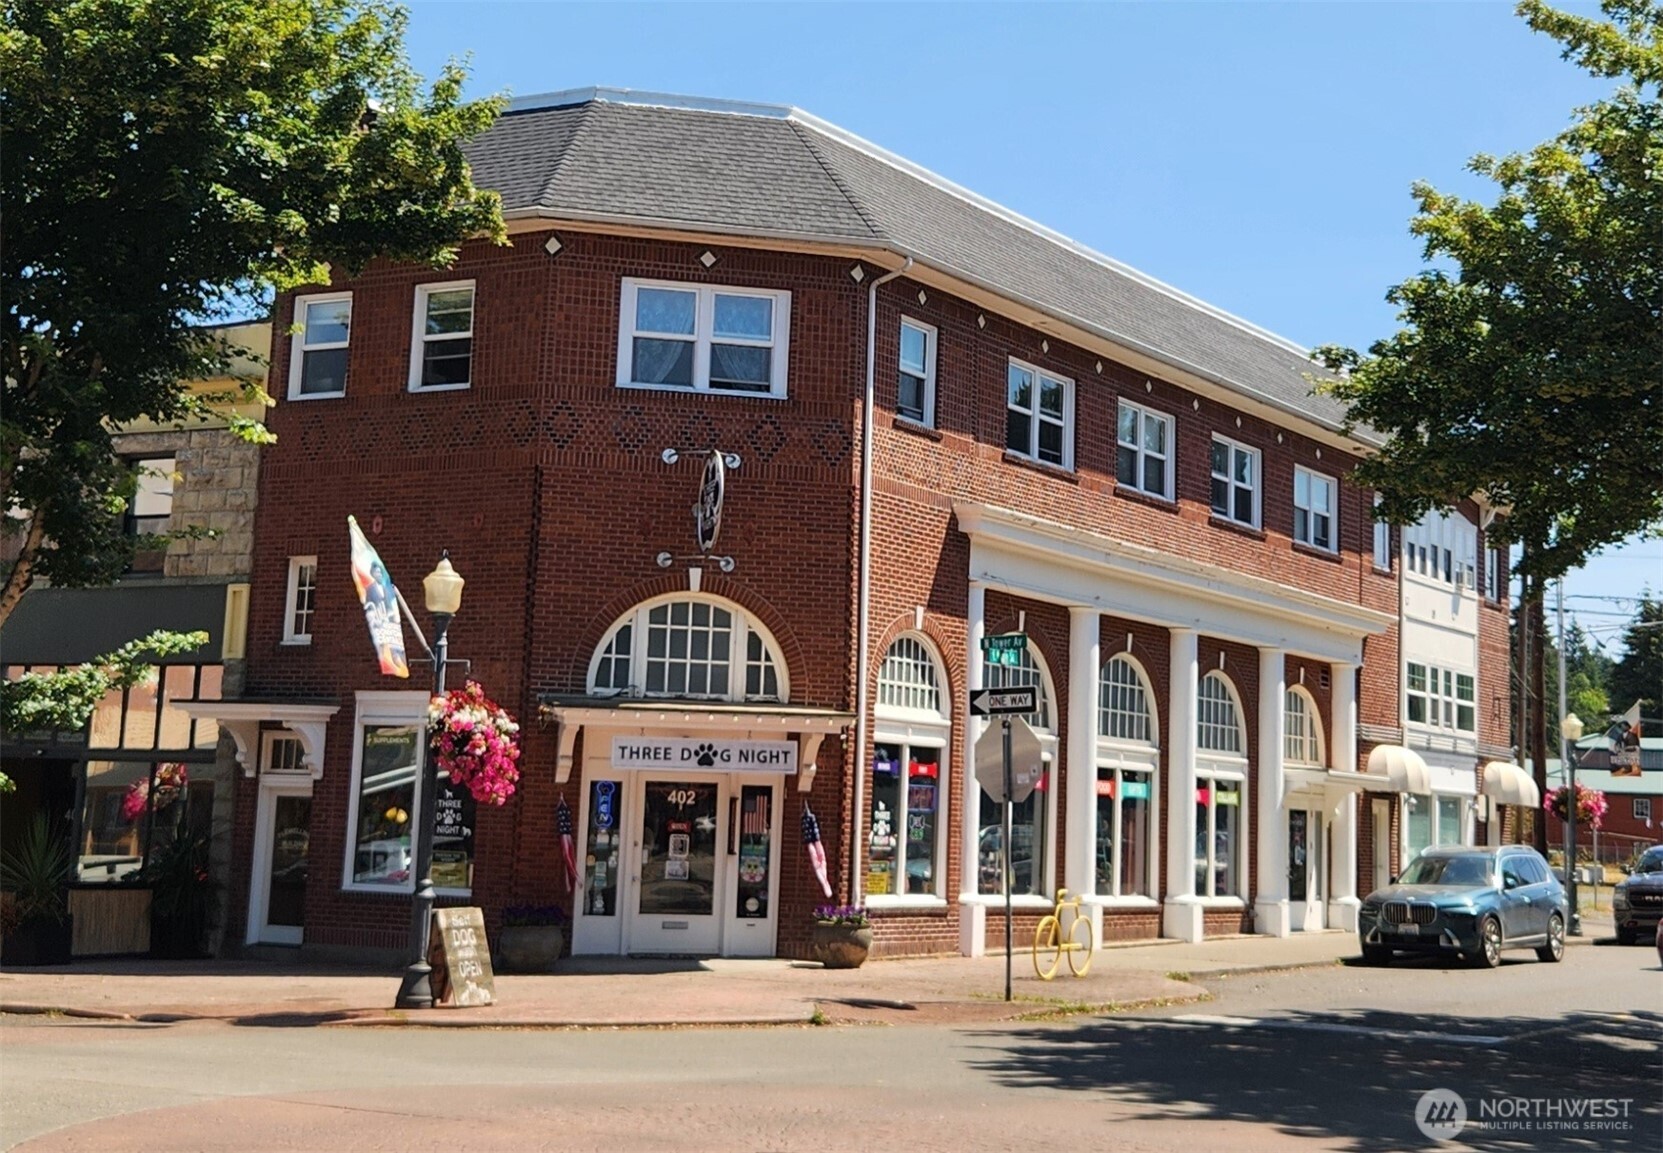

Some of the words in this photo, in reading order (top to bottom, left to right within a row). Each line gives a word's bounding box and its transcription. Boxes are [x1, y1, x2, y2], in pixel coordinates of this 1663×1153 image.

[989, 695, 1007, 707] ONE
[1010, 694, 1029, 706] WAY
[618, 745, 672, 761] THREE
[738, 749, 791, 764] NIGHT
[438, 799, 462, 809] THREE
[667, 789, 696, 805] 402
[436, 825, 460, 835] NIGHT
[452, 928, 477, 946] DOG
[459, 960, 483, 977] OPEN
